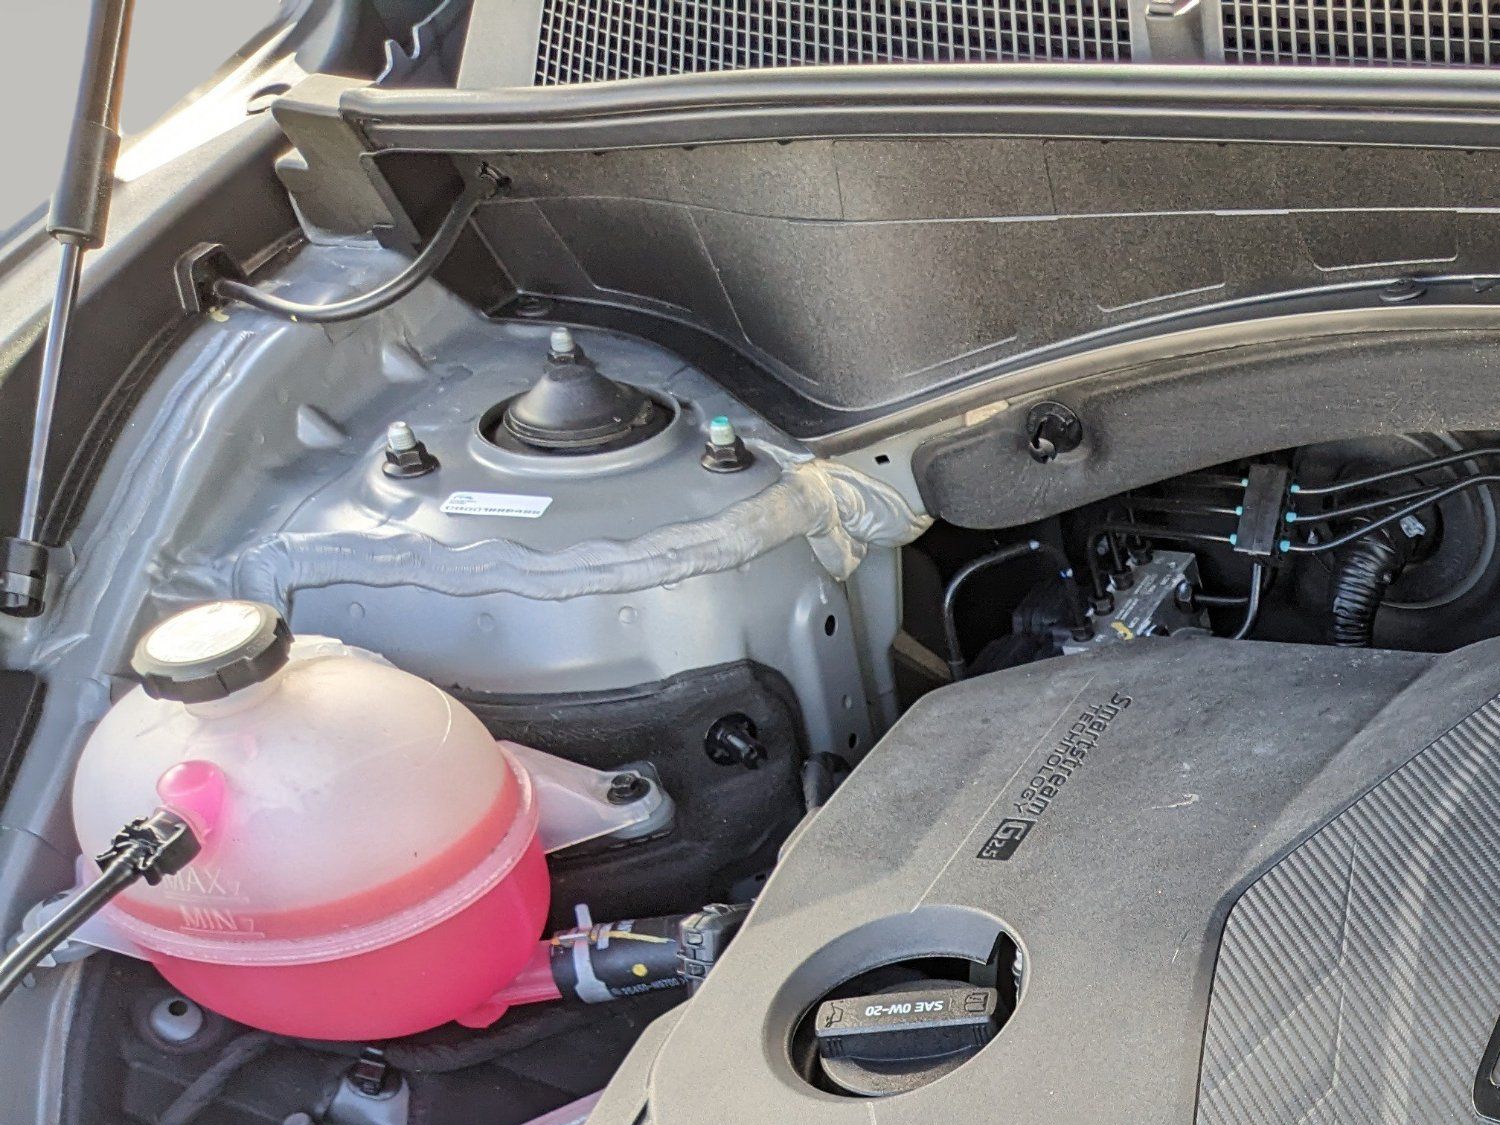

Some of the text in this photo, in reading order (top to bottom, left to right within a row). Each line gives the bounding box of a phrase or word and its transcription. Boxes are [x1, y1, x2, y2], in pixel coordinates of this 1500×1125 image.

[1027, 692, 1133, 816] Smartstream
[162, 866, 226, 896] MAX
[178, 905, 239, 931] MIN
[865, 999, 944, 1017] SAE 0W-20
